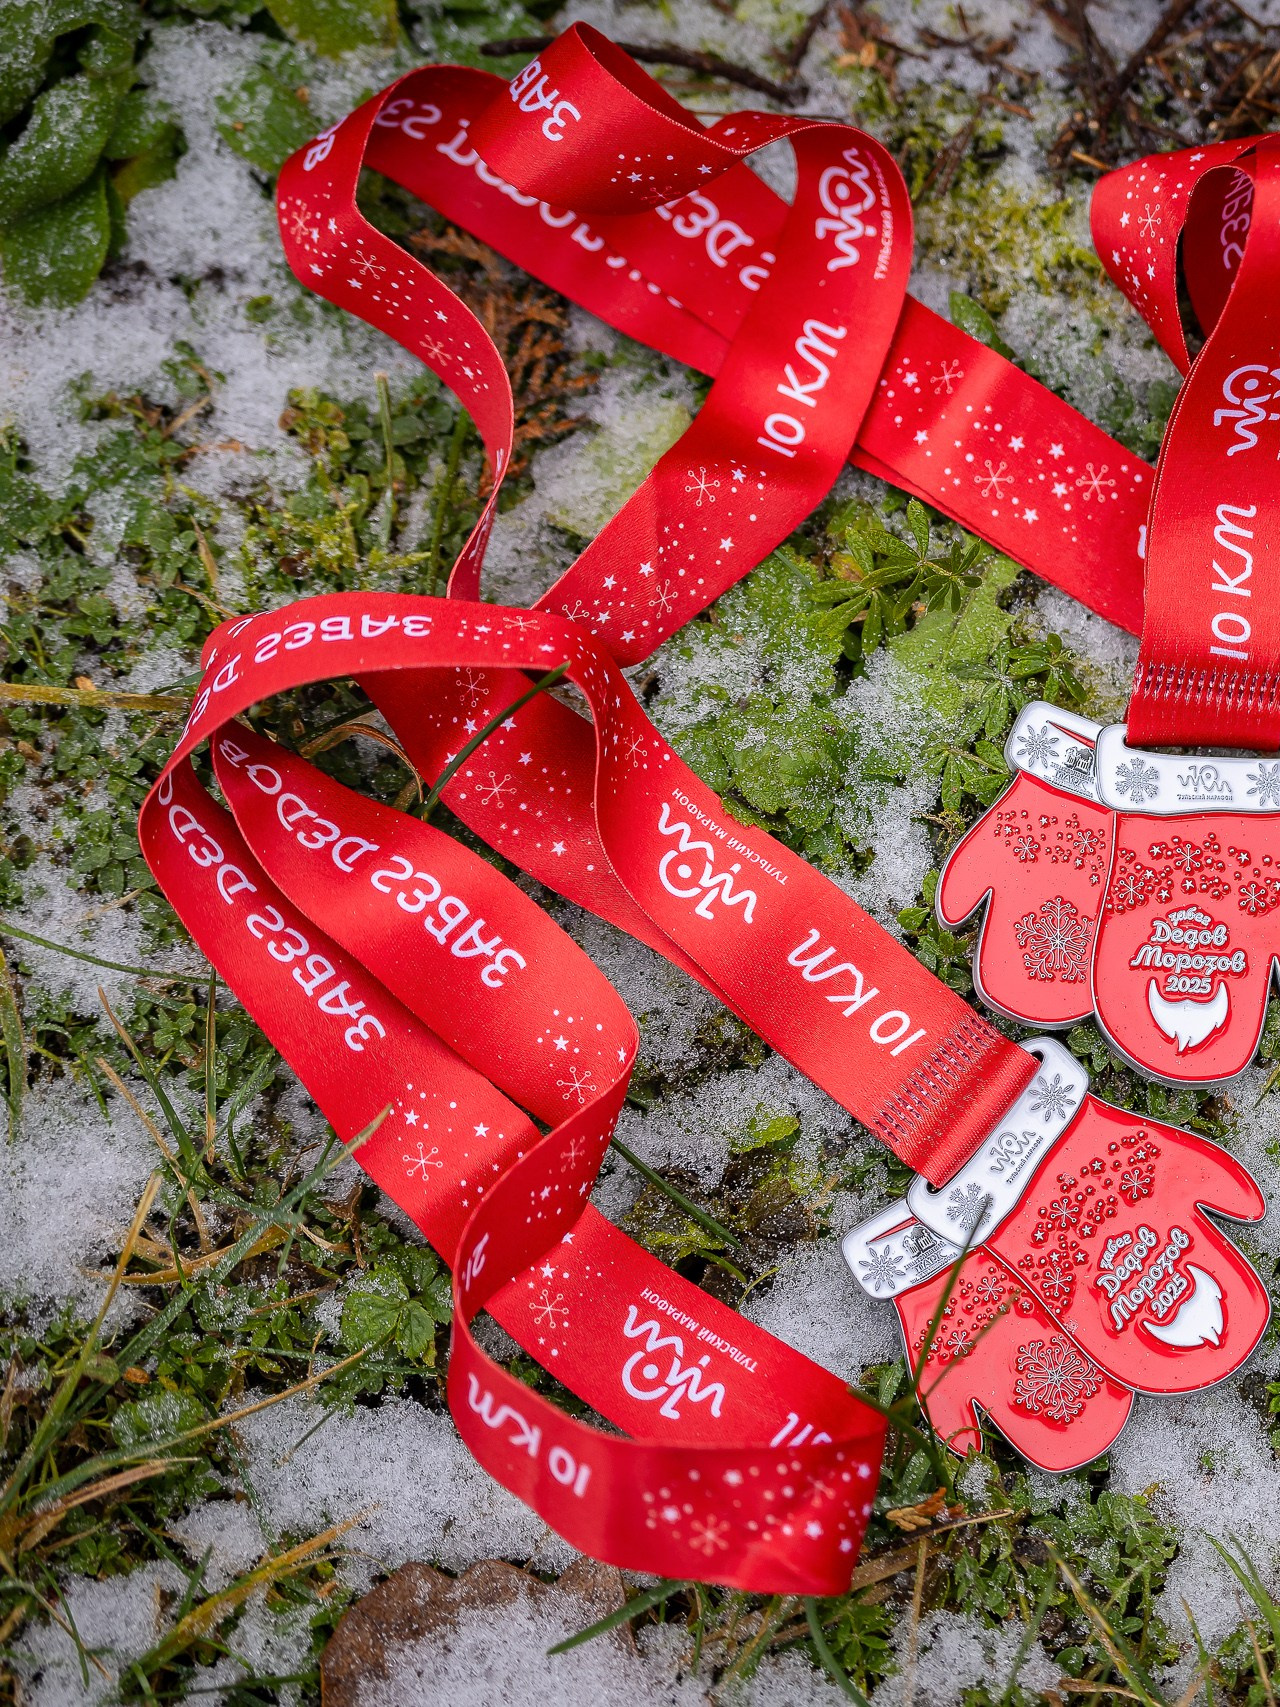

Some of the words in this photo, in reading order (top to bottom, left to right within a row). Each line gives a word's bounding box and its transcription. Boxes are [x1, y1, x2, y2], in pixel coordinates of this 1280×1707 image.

[757, 413, 806, 457] 10
[1210, 612, 1252, 660] 10
[671, 788, 727, 840] МАРАФОН
[727, 837, 789, 886] ТУЛЬСКИЙ
[1150, 920, 1228, 950] Дедов
[1130, 944, 1247, 976] Морозов
[1165, 975, 1212, 994] 2025
[869, 1009, 928, 1058] 10
[1096, 1226, 1157, 1299] Дедов
[1110, 1227, 1190, 1331] Морозов
[640, 1287, 698, 1333] МАРАФОН
[1151, 1272, 1188, 1319] 2025
[697, 1327, 758, 1373] ТУЛЬСКИЙ
